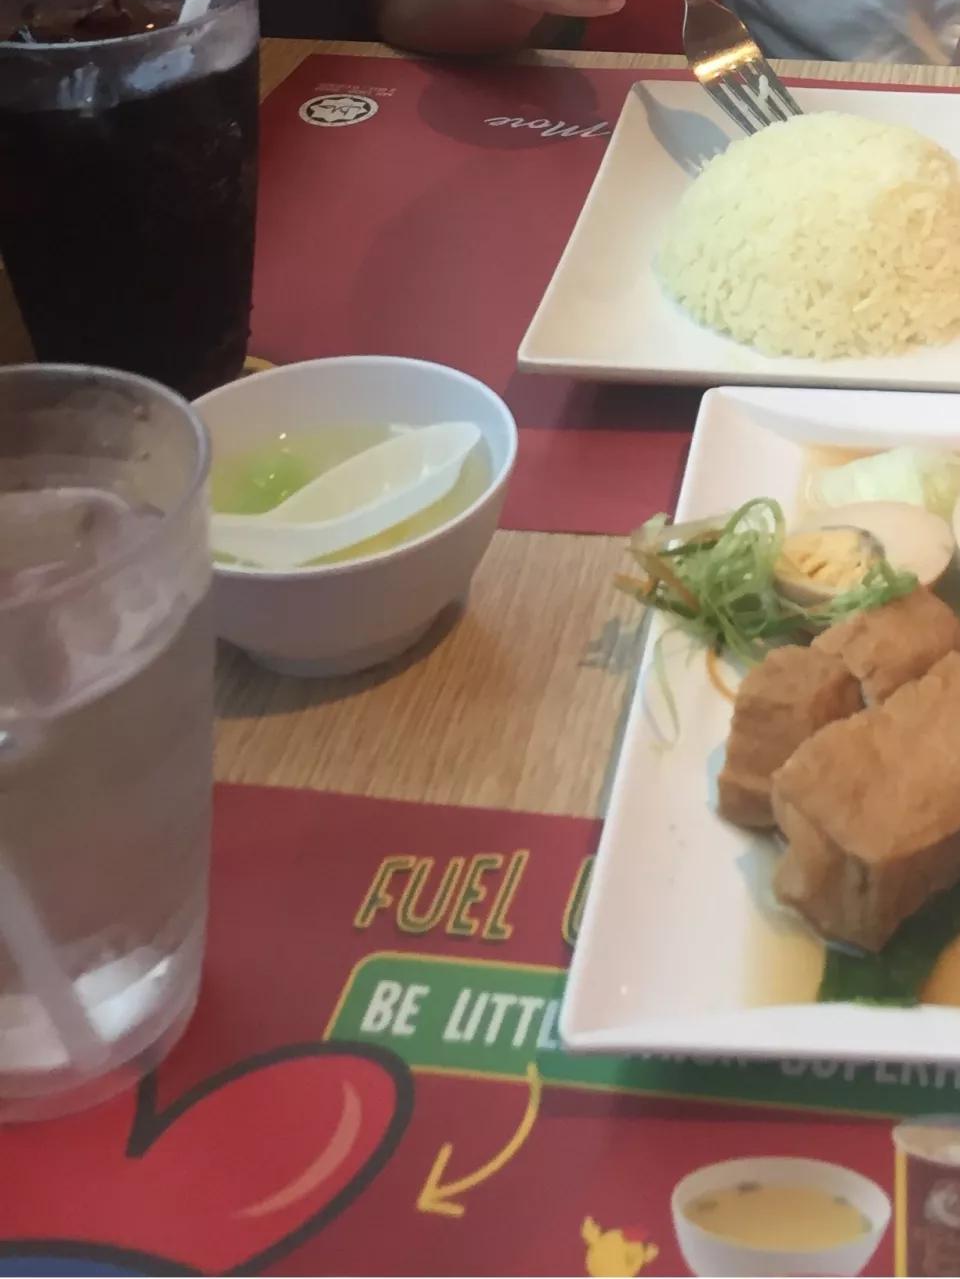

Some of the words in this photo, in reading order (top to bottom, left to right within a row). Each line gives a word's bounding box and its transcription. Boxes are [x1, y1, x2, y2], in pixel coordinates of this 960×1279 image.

[485, 116, 611, 139] More
[353, 848, 531, 941] FUEL
[359, 980, 430, 1038] BE
[442, 988, 563, 1051] LITTL
